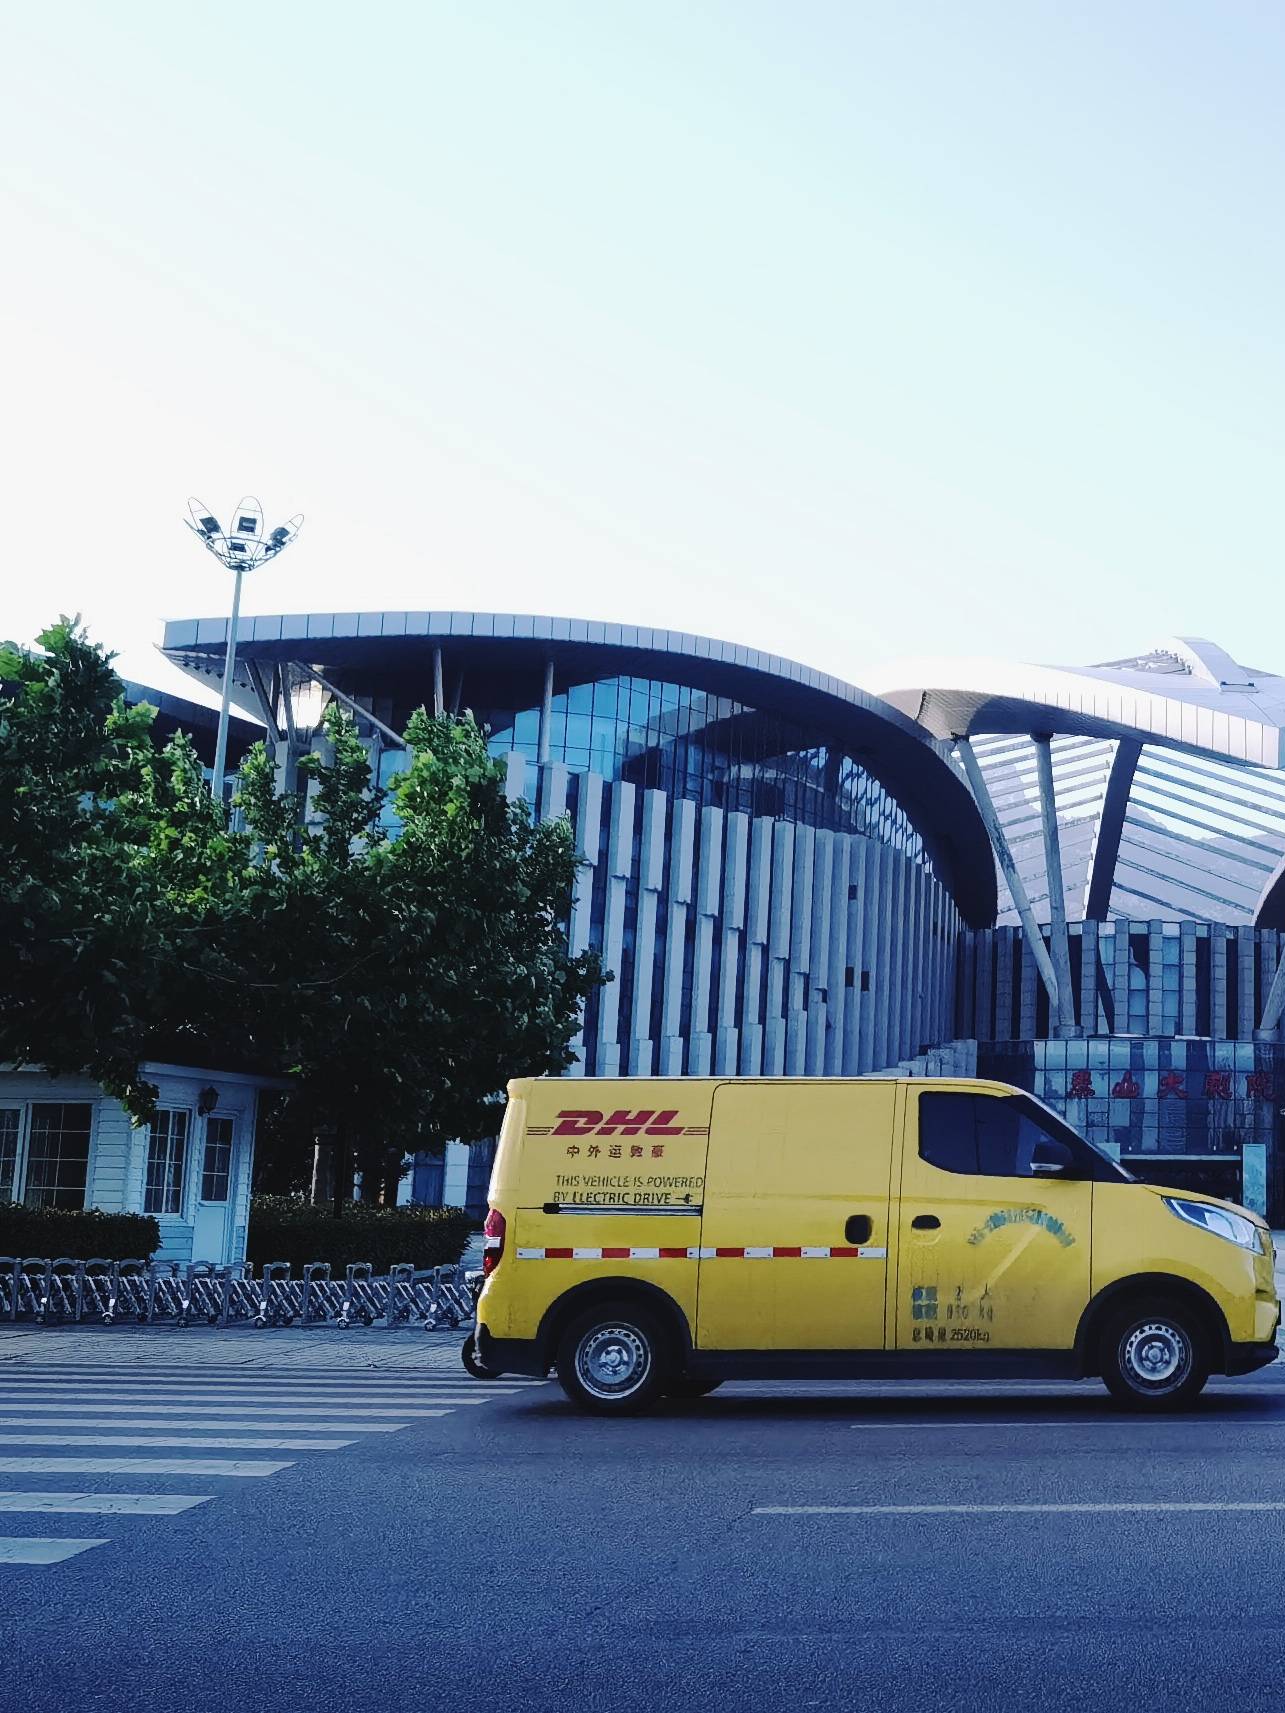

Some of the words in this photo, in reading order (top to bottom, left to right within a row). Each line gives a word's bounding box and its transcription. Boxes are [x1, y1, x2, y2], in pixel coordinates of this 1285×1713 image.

[551, 1110, 685, 1136] DHL
[556, 1175, 580, 1187] THIS
[582, 1175, 630, 1188] VEHICLE
[633, 1177, 644, 1188] IS
[647, 1177, 704, 1188] POWERED
[553, 1191, 568, 1203] BY
[572, 1192, 630, 1204] ELECTRIC
[633, 1192, 672, 1205] DRIVE
